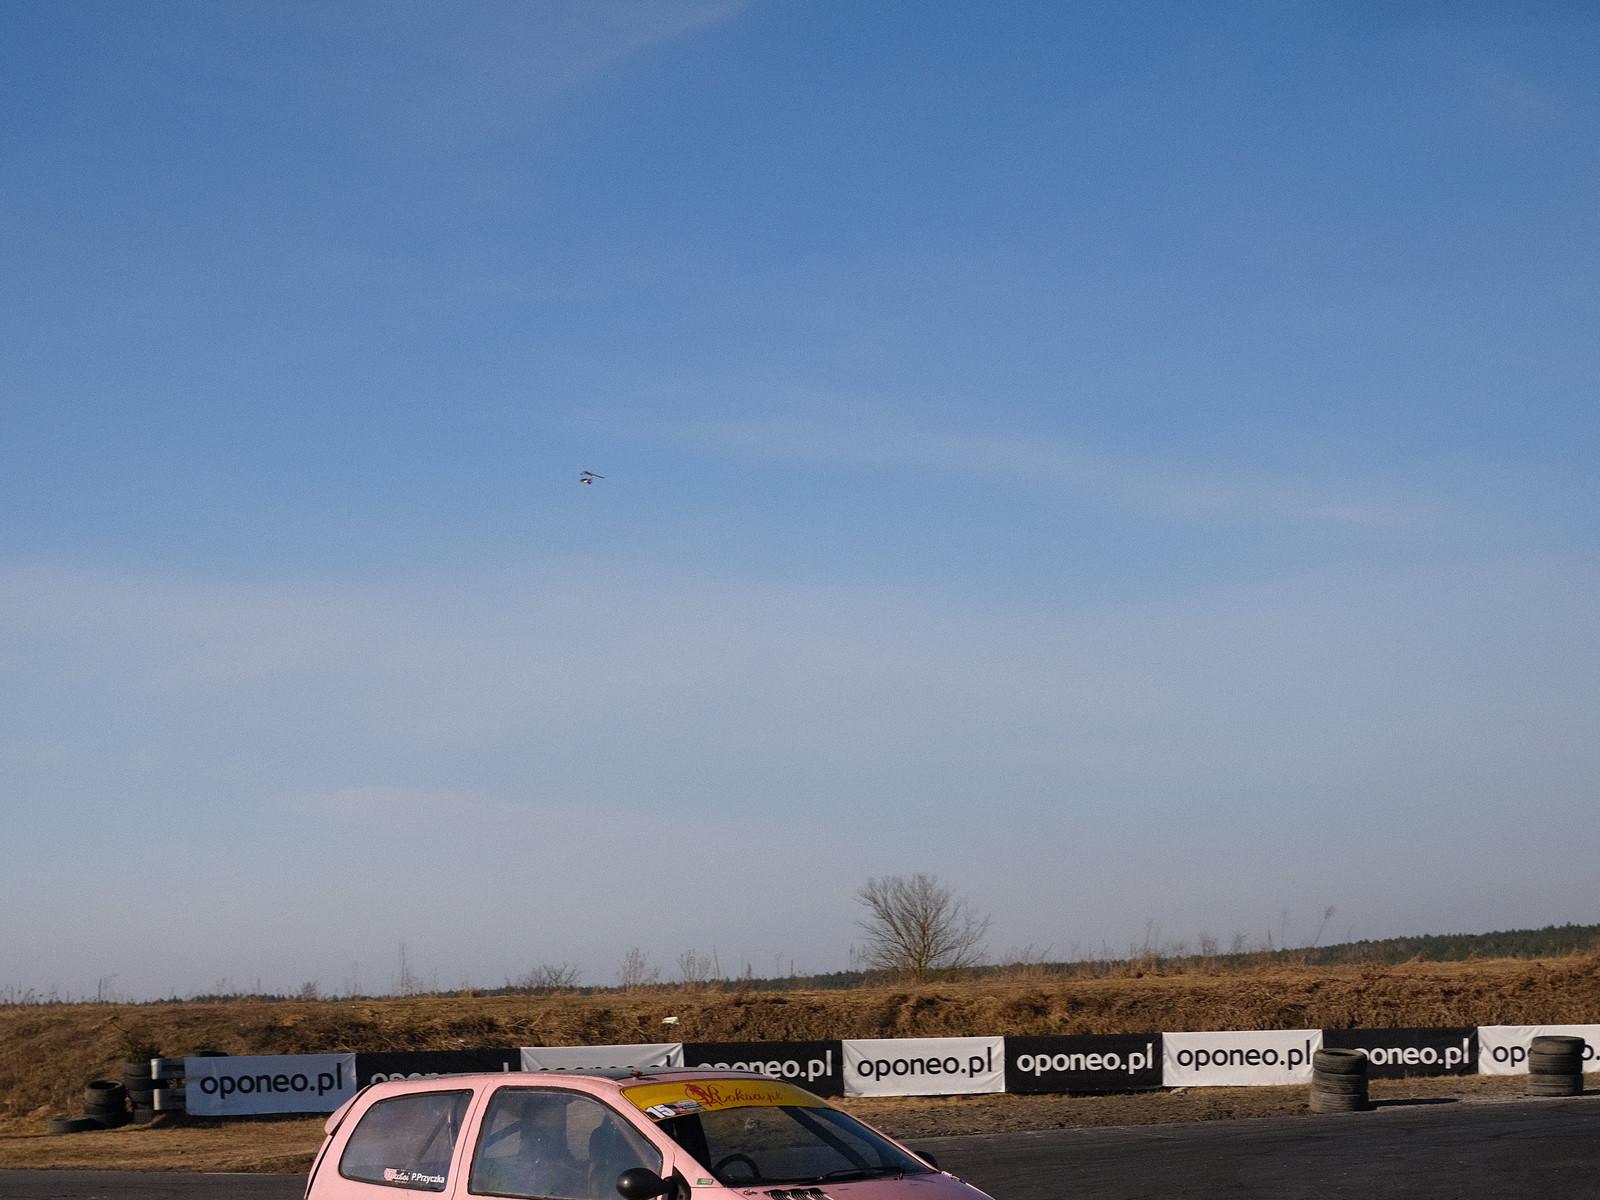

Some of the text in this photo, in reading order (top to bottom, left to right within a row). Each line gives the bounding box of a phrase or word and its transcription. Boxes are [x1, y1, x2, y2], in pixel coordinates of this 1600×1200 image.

[857, 1046, 992, 1081] oponeo.pl
[1016, 1042, 1153, 1076] oponeo.pl
[1176, 1039, 1311, 1071] oponeo.pl
[1354, 1037, 1470, 1069] oneo.pl
[200, 1062, 342, 1099] oponeo.pl
[645, 1104, 676, 1119] 15
